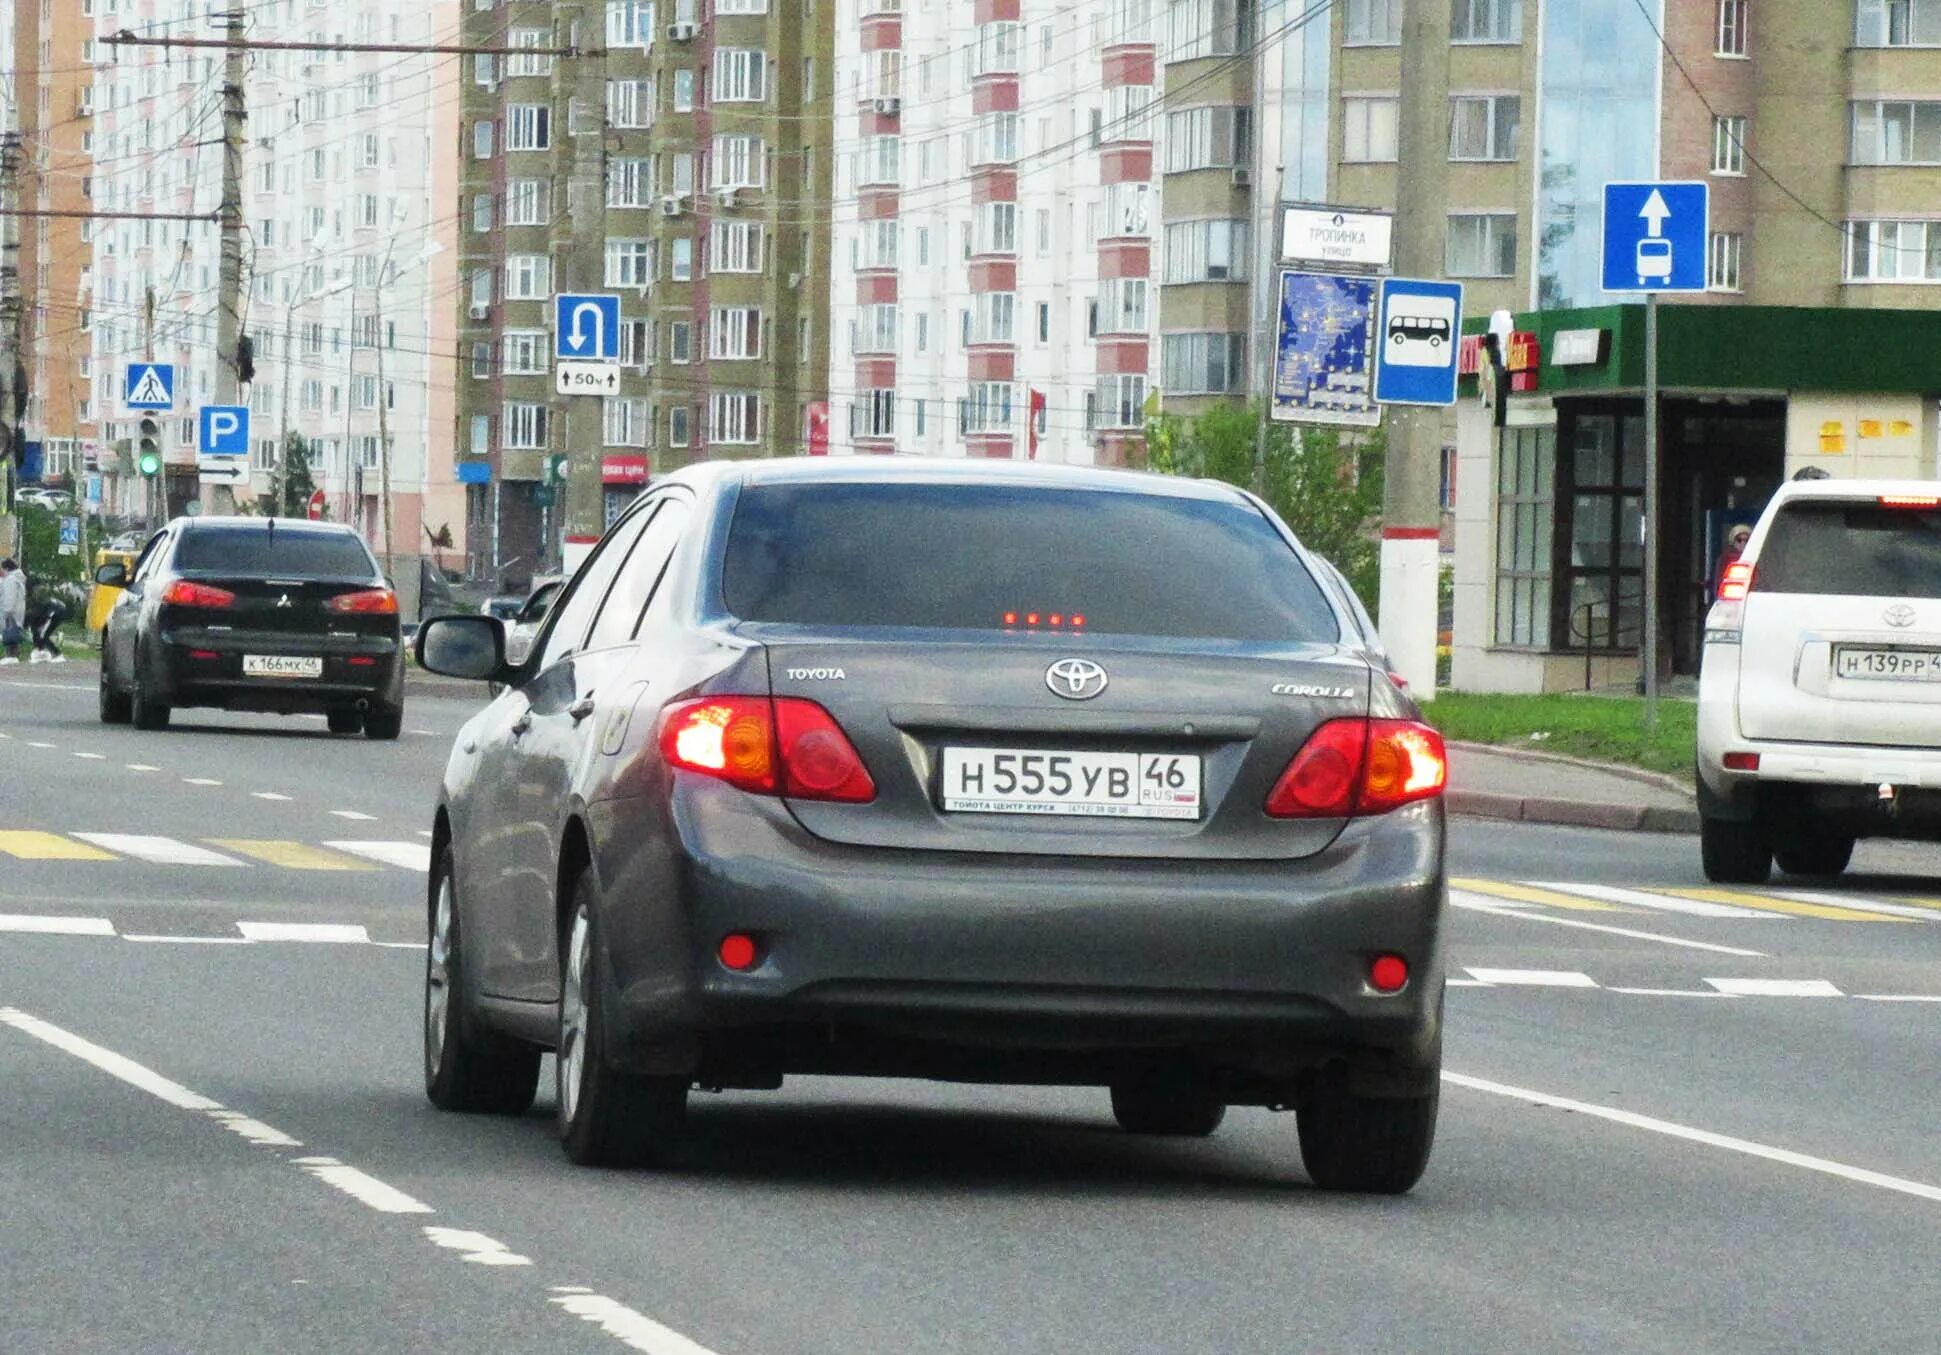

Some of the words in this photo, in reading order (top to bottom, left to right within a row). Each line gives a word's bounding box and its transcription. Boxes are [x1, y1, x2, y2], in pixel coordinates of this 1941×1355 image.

[1309, 228, 1366, 244] ТРОПИНКА
[210, 412, 239, 448] P
[786, 668, 846, 680] TOYOTA
[1271, 684, 1355, 698] COROLLA
[1145, 757, 1186, 789] 46
[1142, 788, 1173, 801] RUS
